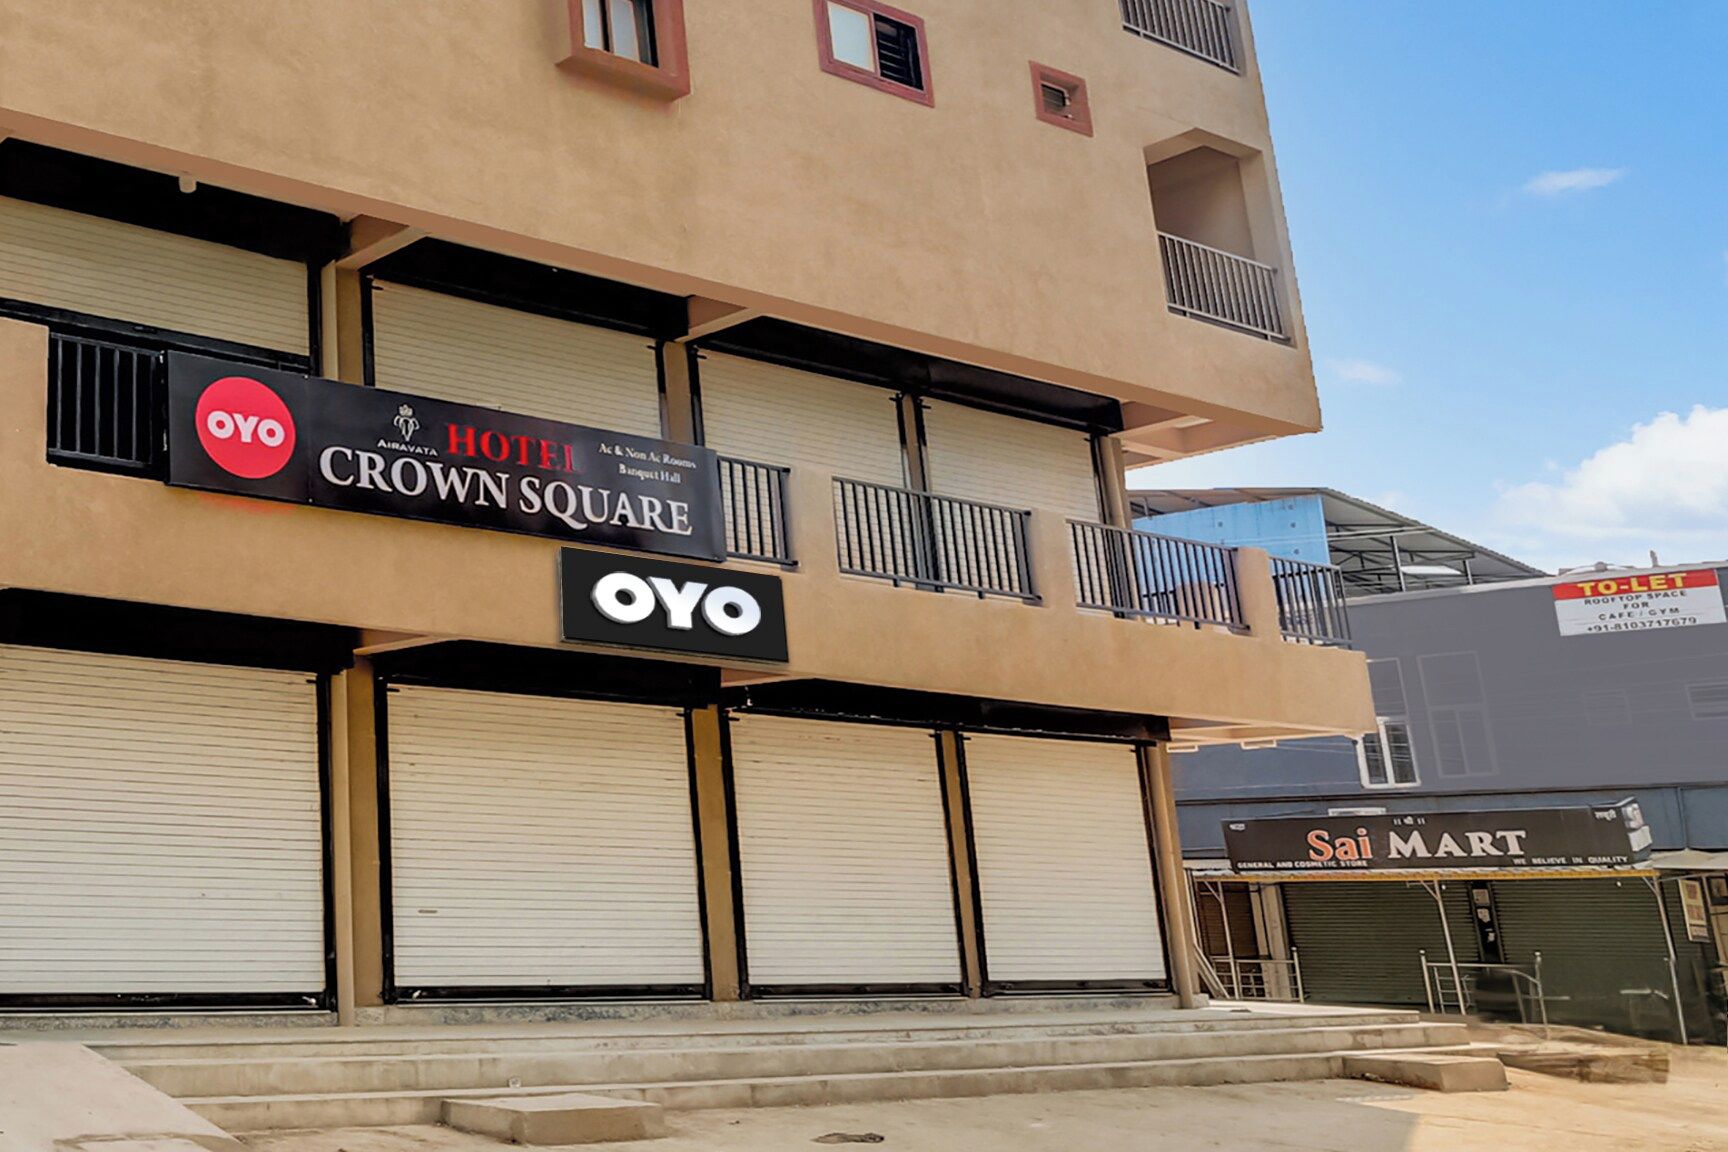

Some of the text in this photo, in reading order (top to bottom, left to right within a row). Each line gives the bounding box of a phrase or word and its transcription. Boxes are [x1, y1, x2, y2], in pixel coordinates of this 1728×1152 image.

[207, 410, 285, 447] OYO
[614, 445, 623, 456] &
[625, 447, 647, 460] Non
[662, 453, 697, 469] Rooms
[660, 470, 682, 484] Hall
[320, 446, 693, 536] CROWN SQUARE
[1577, 573, 1687, 596] TO-LET
[590, 571, 762, 636] OYO
[1584, 590, 1687, 605] ROOFTOP SPACE
[1623, 601, 1650, 609] FOR
[1598, 611, 1634, 620] CAFE
[1648, 607, 1680, 616] GYM
[1307, 827, 1526, 861] Sai MART
[1294, 860, 1337, 868] COSMETIC
[1531, 857, 1567, 865] BELIEVE
[1588, 855, 1628, 864] QUALITY
